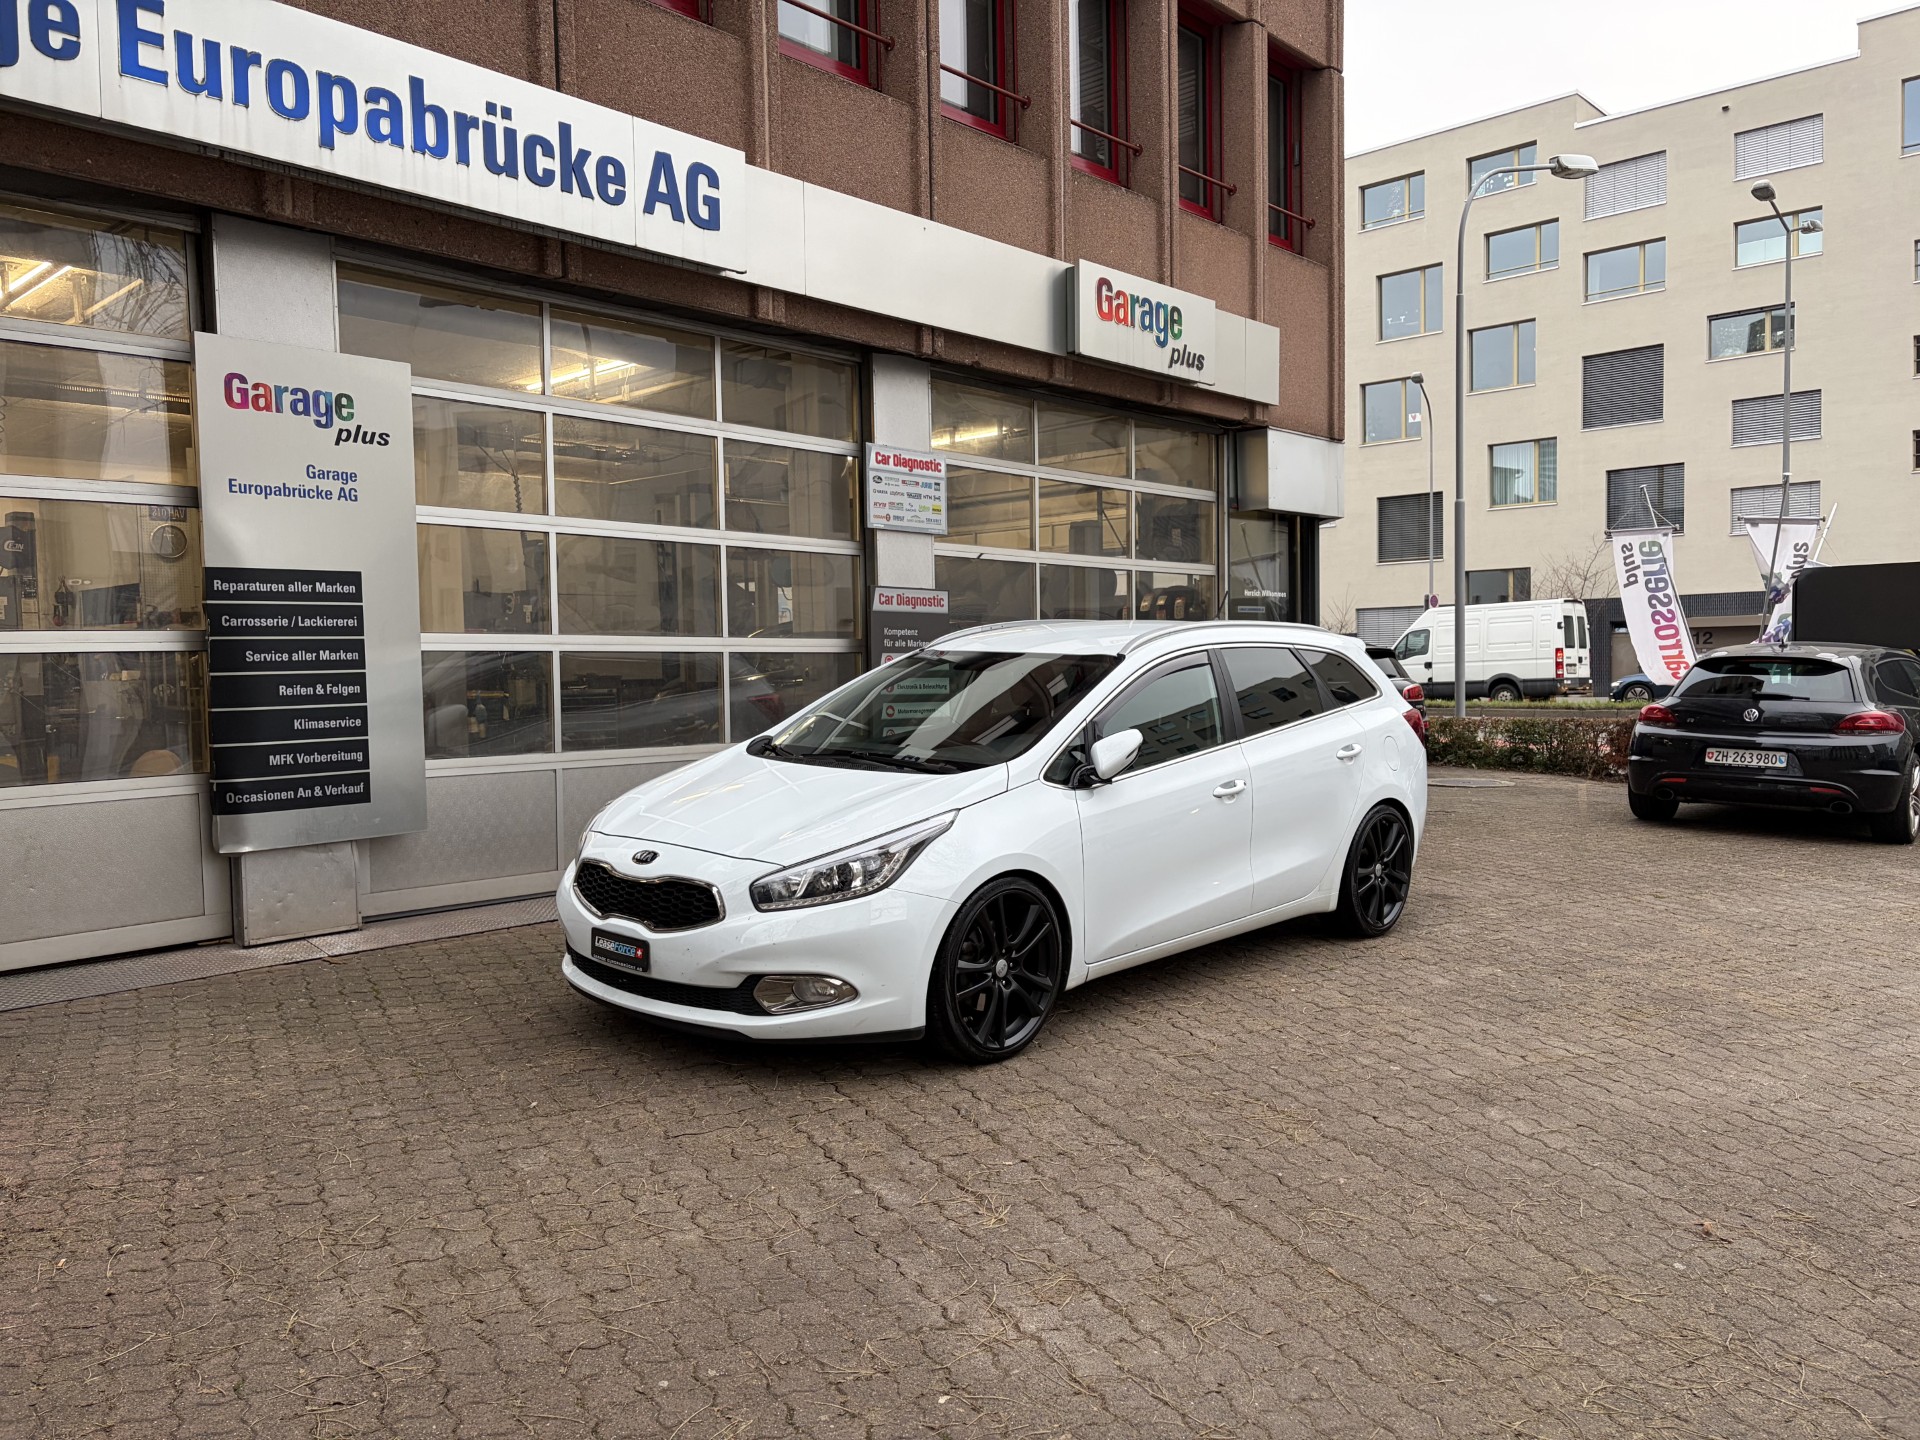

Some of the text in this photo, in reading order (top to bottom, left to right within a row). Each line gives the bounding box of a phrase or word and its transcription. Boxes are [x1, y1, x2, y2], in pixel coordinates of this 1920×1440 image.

[117, 0, 627, 206] Europabrücke
[643, 151, 721, 231] AG
[1095, 277, 1183, 349] Garage
[1168, 344, 1205, 371] plus
[223, 372, 355, 429] Garage
[334, 424, 391, 447] plus
[875, 451, 942, 473] Car Diagnostic
[305, 464, 358, 485] Garage
[228, 478, 359, 502] Europabrücke AG
[213, 579, 356, 594] Reparaturen aller Marken
[878, 592, 945, 610] Car Diagnostic
[221, 615, 358, 628] Carrosserie / Lackiererei
[883, 627, 919, 638] Kompetenz
[1692, 631, 1713, 645] 12
[883, 638, 894, 647] für
[894, 639, 906, 647] alle
[245, 650, 359, 662] Service aller Marken
[279, 683, 361, 696] Reifen & Felgen
[293, 716, 362, 730] Klimaservice
[269, 750, 363, 766] MFK Vorbereitung
[226, 782, 364, 804] Occasionen An & Verkauf
[595, 935, 636, 958] LeaseForce
